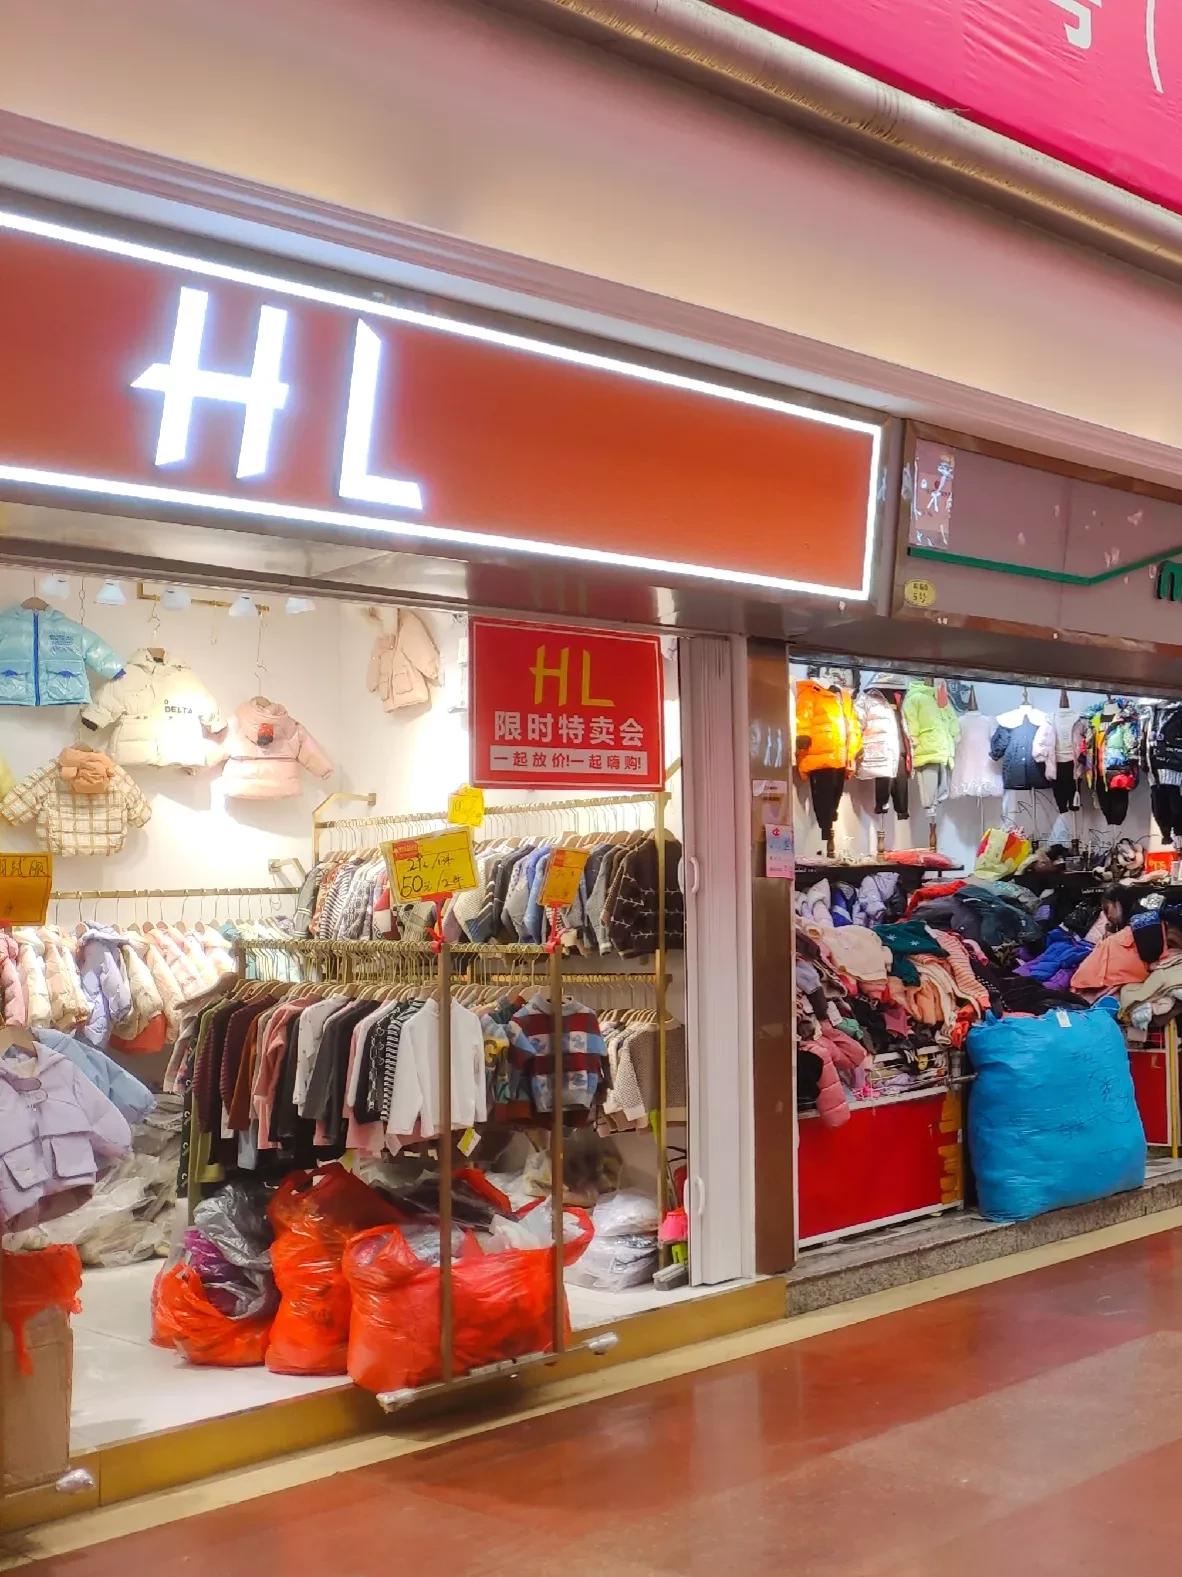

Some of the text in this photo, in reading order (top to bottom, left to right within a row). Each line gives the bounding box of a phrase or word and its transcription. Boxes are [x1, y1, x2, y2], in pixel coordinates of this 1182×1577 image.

[130, 285, 424, 510] HL
[529, 643, 616, 708] HL
[494, 710, 644, 747] 限时特卖会
